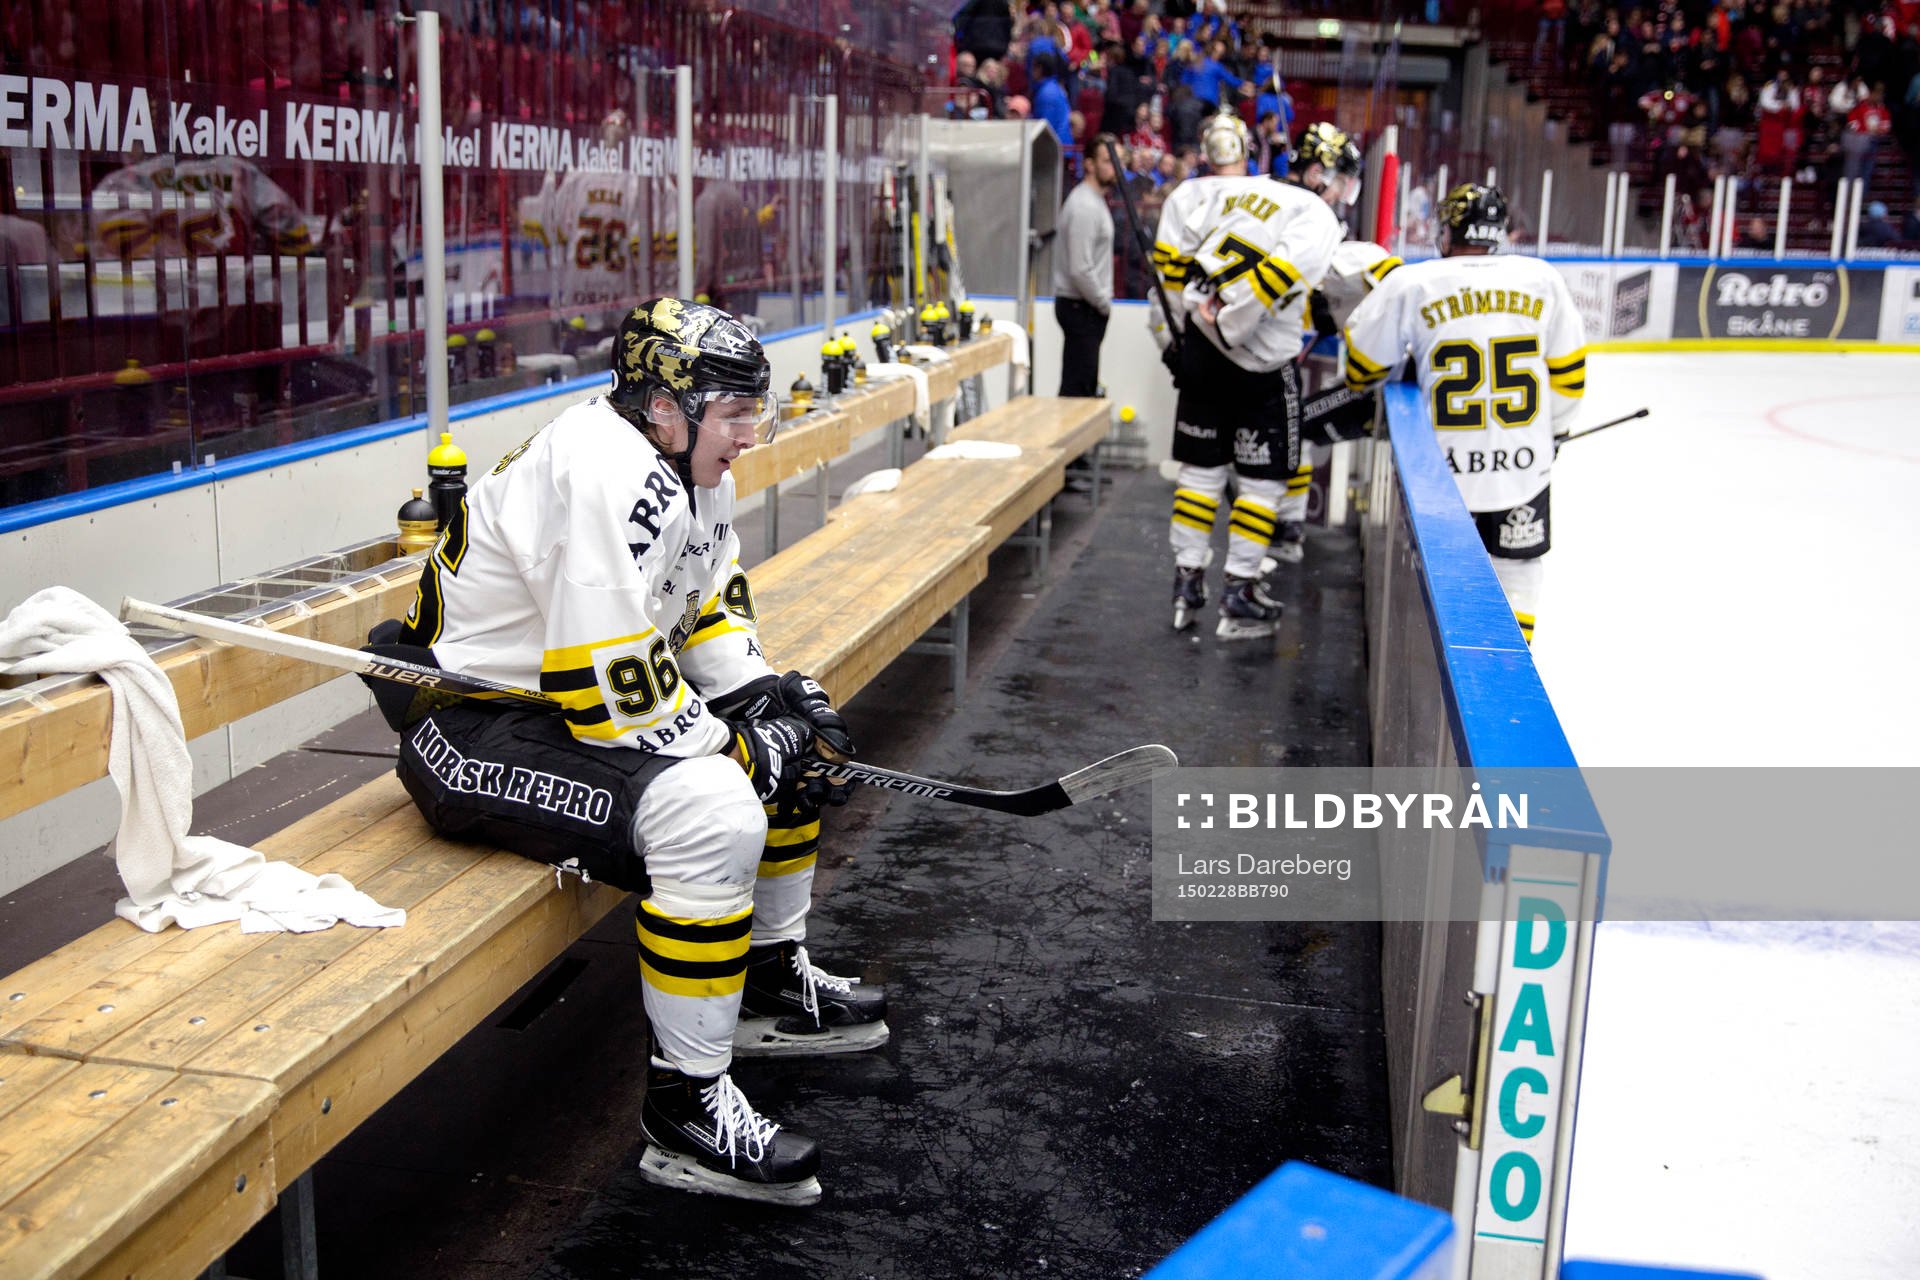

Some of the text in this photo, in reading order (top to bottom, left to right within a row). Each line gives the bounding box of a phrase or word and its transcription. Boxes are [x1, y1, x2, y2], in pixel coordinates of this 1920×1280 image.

[0, 75, 157, 153] ERMA
[169, 101, 268, 158] Kakel
[285, 101, 407, 165] KERMA
[490, 121, 574, 172] KERMA
[577, 136, 624, 174] Kakel
[630, 136, 680, 178] KERM
[1420, 286, 1545, 329] STRÖMBERG
[1717, 272, 1829, 307] Retro
[1727, 310, 1811, 337] SKÅNE
[1430, 335, 1540, 431] 25
[1446, 446, 1535, 473] ÅBRO
[410, 662, 440, 675] KOVACS
[606, 636, 681, 718] 96
[636, 698, 701, 753] ÅBRO
[411, 717, 613, 825] NORSK REPRO
[1489, 896, 1568, 1222] DACO
